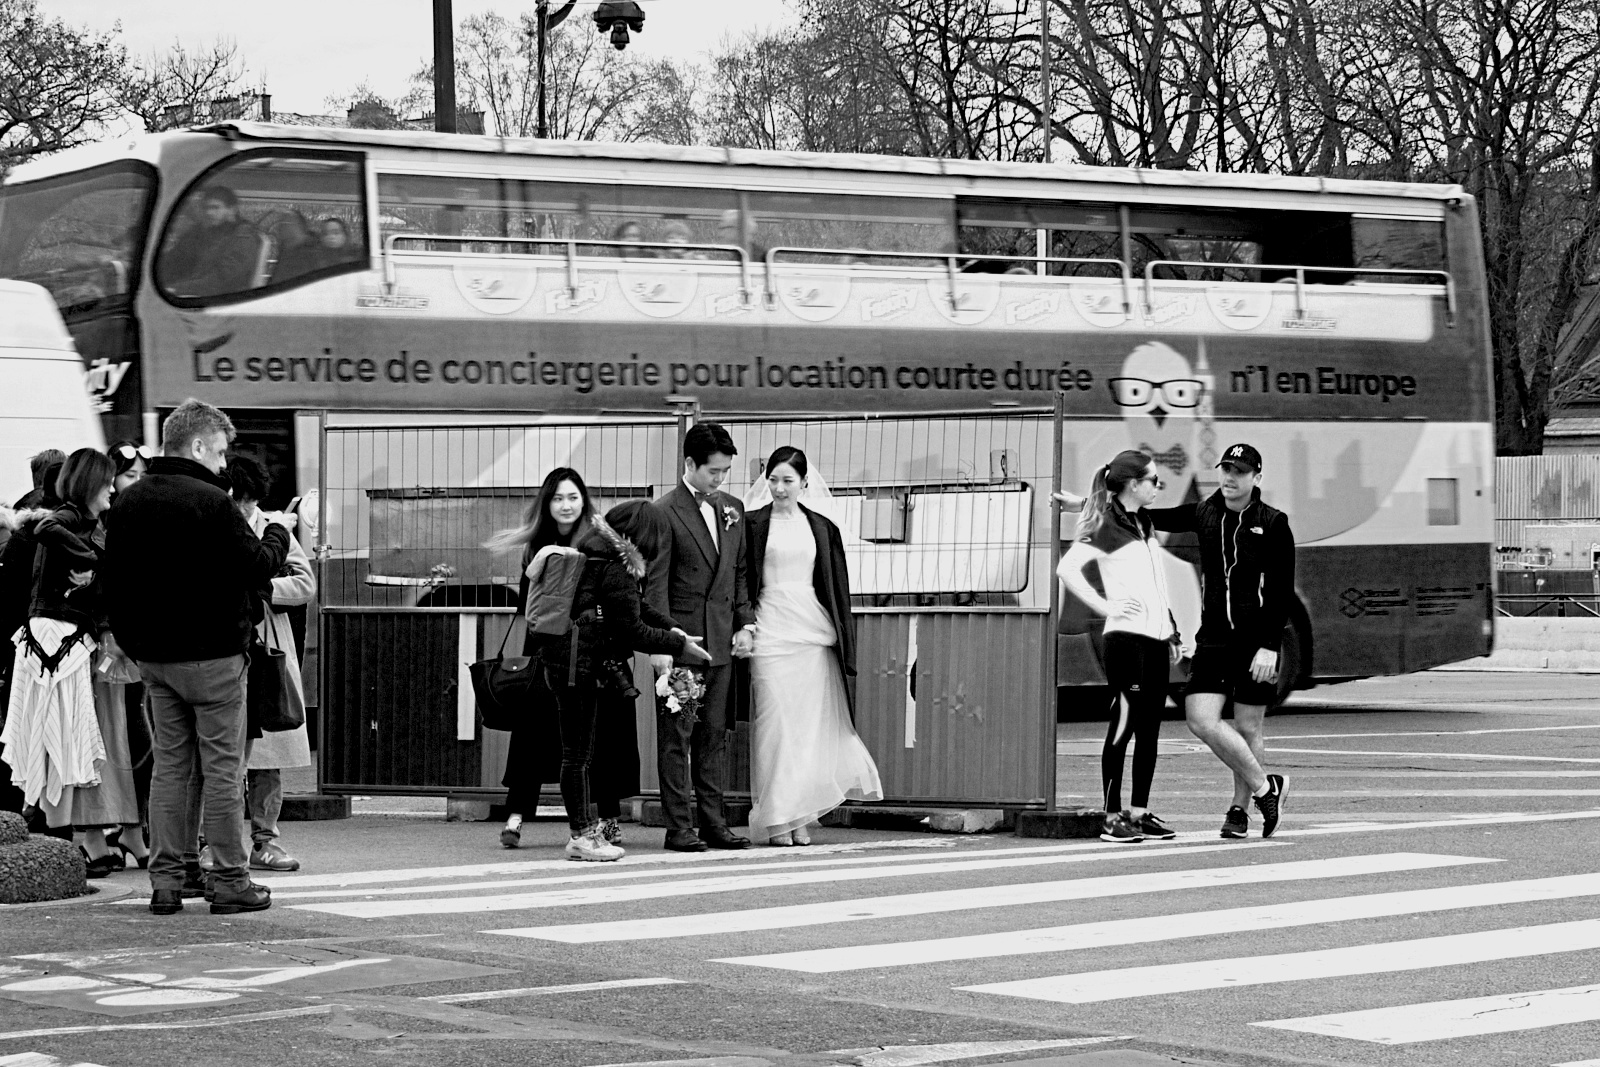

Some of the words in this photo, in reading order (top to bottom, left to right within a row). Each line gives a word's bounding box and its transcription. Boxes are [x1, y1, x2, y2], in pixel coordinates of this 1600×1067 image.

[192, 350, 235, 383] Le
[244, 348, 376, 383] service
[387, 351, 432, 384] de
[441, 352, 660, 393] conciergerie
[670, 359, 748, 394] pour
[756, 356, 889, 390] location
[897, 362, 996, 391] courte
[1004, 360, 1093, 392] durée
[1277, 371, 1311, 394] en
[1316, 366, 1417, 403] Europe
